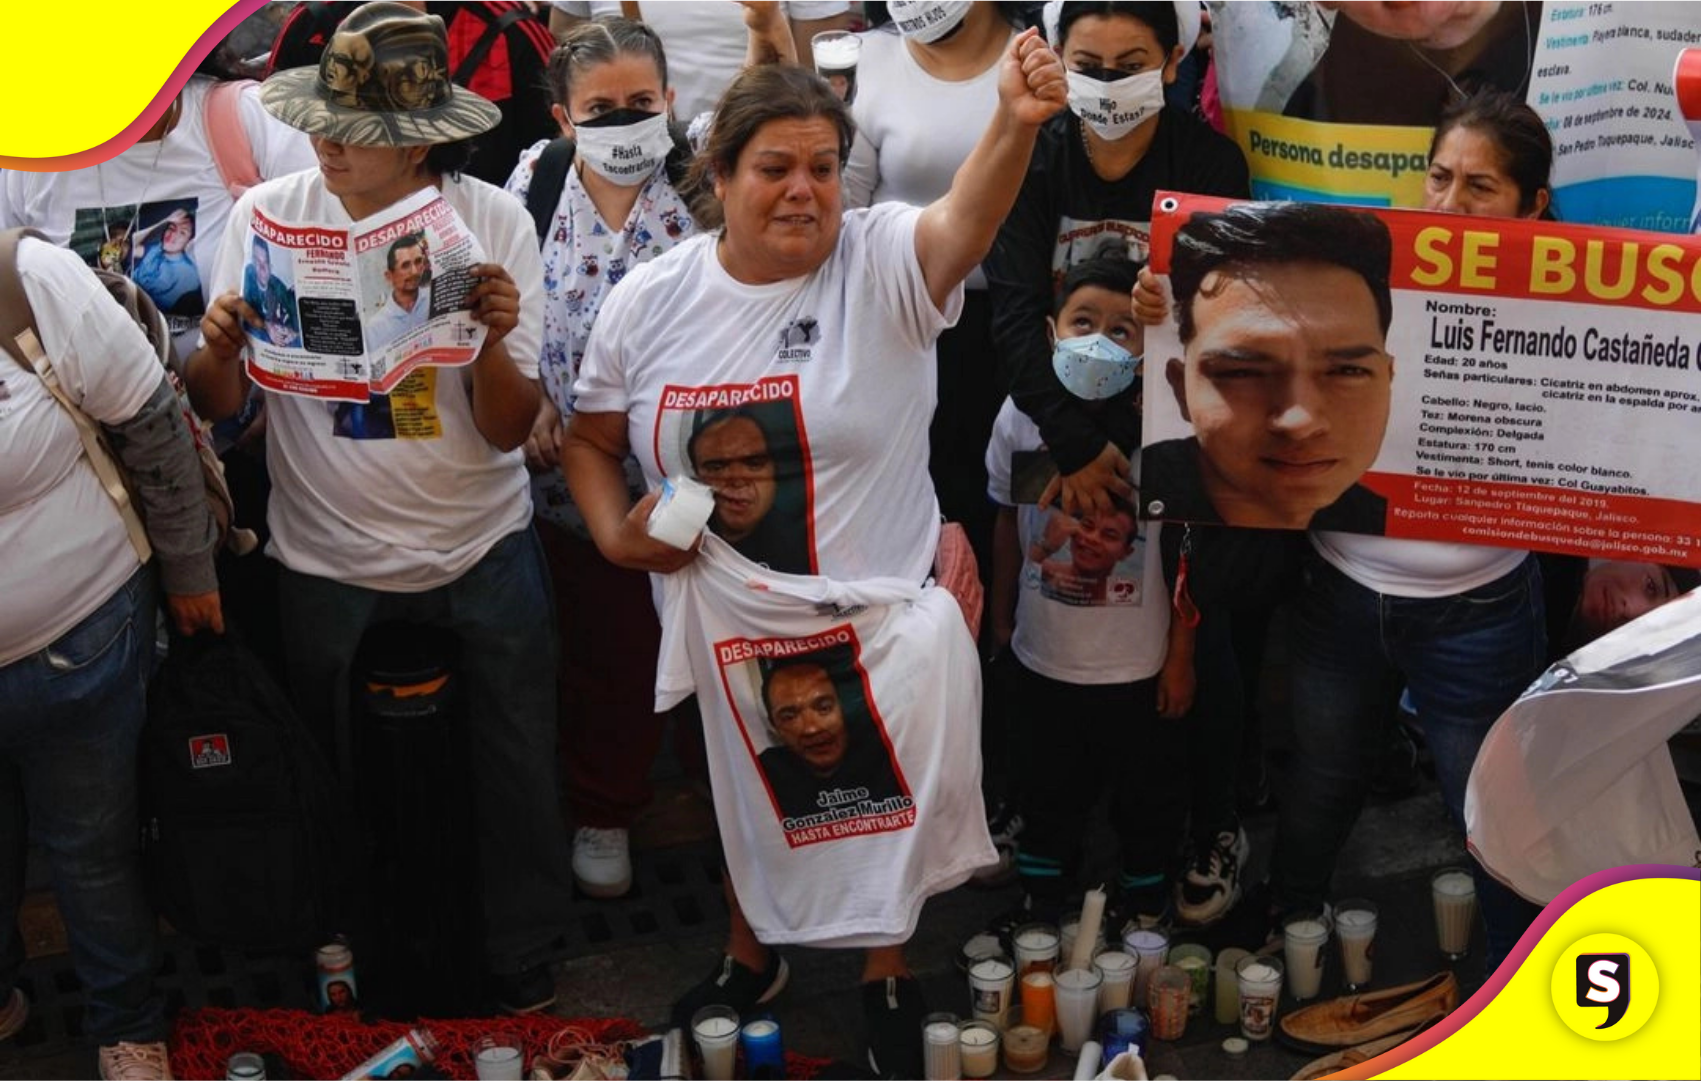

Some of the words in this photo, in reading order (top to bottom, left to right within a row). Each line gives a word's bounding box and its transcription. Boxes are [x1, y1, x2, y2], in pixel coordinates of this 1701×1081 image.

[1628, 78, 1650, 93] Col.
[1626, 106, 1639, 118] de
[612, 145, 643, 159] #Hasta
[1249, 130, 1324, 167] Persona
[1328, 144, 1429, 177] desapa
[1557, 143, 1574, 157] San
[358, 200, 450, 252] DESAPARECID
[1410, 226, 1500, 290] SE
[1529, 235, 1701, 306] BUS
[1425, 300, 1497, 317] Nombre:
[1431, 316, 1475, 351] Luis
[1480, 320, 1577, 359] Fernando
[1583, 327, 1690, 370] Castañeda
[1424, 354, 1459, 366] Edad:
[1461, 357, 1477, 367] 20
[1479, 360, 1508, 370] años
[664, 380, 794, 407] DESAPARECIDO
[1423, 369, 1460, 380] Señas
[1463, 372, 1537, 387] particulares:
[1540, 377, 1585, 390] Cicatriz
[1588, 383, 1603, 391] en
[1606, 383, 1661, 396] abdomen
[1663, 389, 1701, 402] aprox.
[1421, 395, 1471, 407] Cabello:
[1473, 398, 1512, 411] Negro,
[1515, 402, 1547, 413] lacio.
[1541, 390, 1585, 401] cicatriz
[1588, 393, 1603, 402] en
[1605, 394, 1616, 404] la
[1618, 397, 1665, 408] espalda
[1667, 402, 1688, 411] por
[1421, 410, 1444, 420] Tez:
[1447, 412, 1491, 424] Morena
[1494, 415, 1543, 427] obscura
[1419, 422, 1494, 436] Complexión:
[1496, 428, 1545, 441] Delgada
[1418, 437, 1471, 450] Estatura:
[1474, 442, 1495, 452] 170
[1498, 445, 1516, 454] cm
[1416, 450, 1485, 465] Vestimenta:
[1487, 457, 1523, 468] Short,
[1525, 459, 1555, 470] tenis
[1557, 462, 1588, 474] color
[1590, 465, 1633, 479] blanco.
[1416, 466, 1431, 475] Se
[1434, 467, 1445, 477] le
[1468, 470, 1489, 481] por
[1491, 471, 1528, 484] última
[1530, 476, 1554, 486] vez:
[1557, 477, 1578, 487] Col
[1581, 480, 1650, 496] Guayabitos.
[1413, 481, 1453, 493] Fecha:
[1457, 485, 1471, 495] 12
[1473, 485, 1488, 496] de
[1491, 488, 1556, 502] septiembre
[1558, 494, 1577, 504] del
[1442, 512, 1498, 525] cualquier
[1573, 525, 1607, 537] sobre
[1608, 528, 1620, 538] la
[720, 630, 850, 663] DESAPARECIDO
[817, 786, 870, 807] Jaime
[860, 796, 915, 817] Murillo
[790, 828, 832, 844] HASTA
[833, 809, 915, 837] ENCONTRARTE
